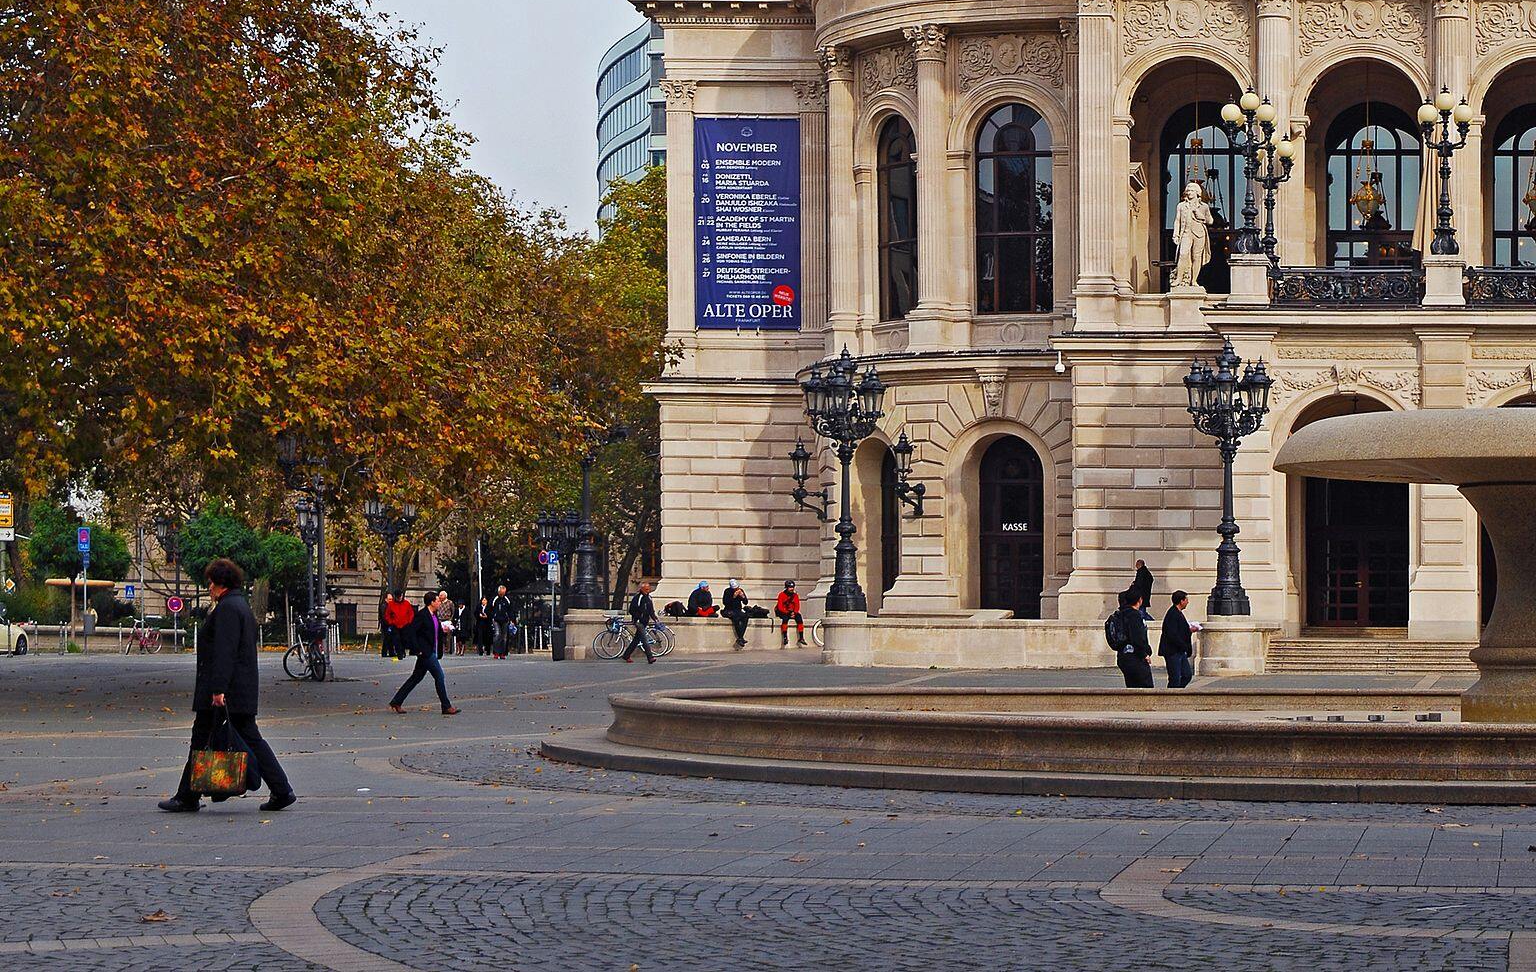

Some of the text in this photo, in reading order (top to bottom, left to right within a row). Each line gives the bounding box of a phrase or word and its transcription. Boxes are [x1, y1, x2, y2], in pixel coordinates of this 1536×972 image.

[717, 143, 777, 152] NOVEMBER
[703, 304, 793, 317] ALTE OPER
[1002, 523, 1028, 531] KASSE
